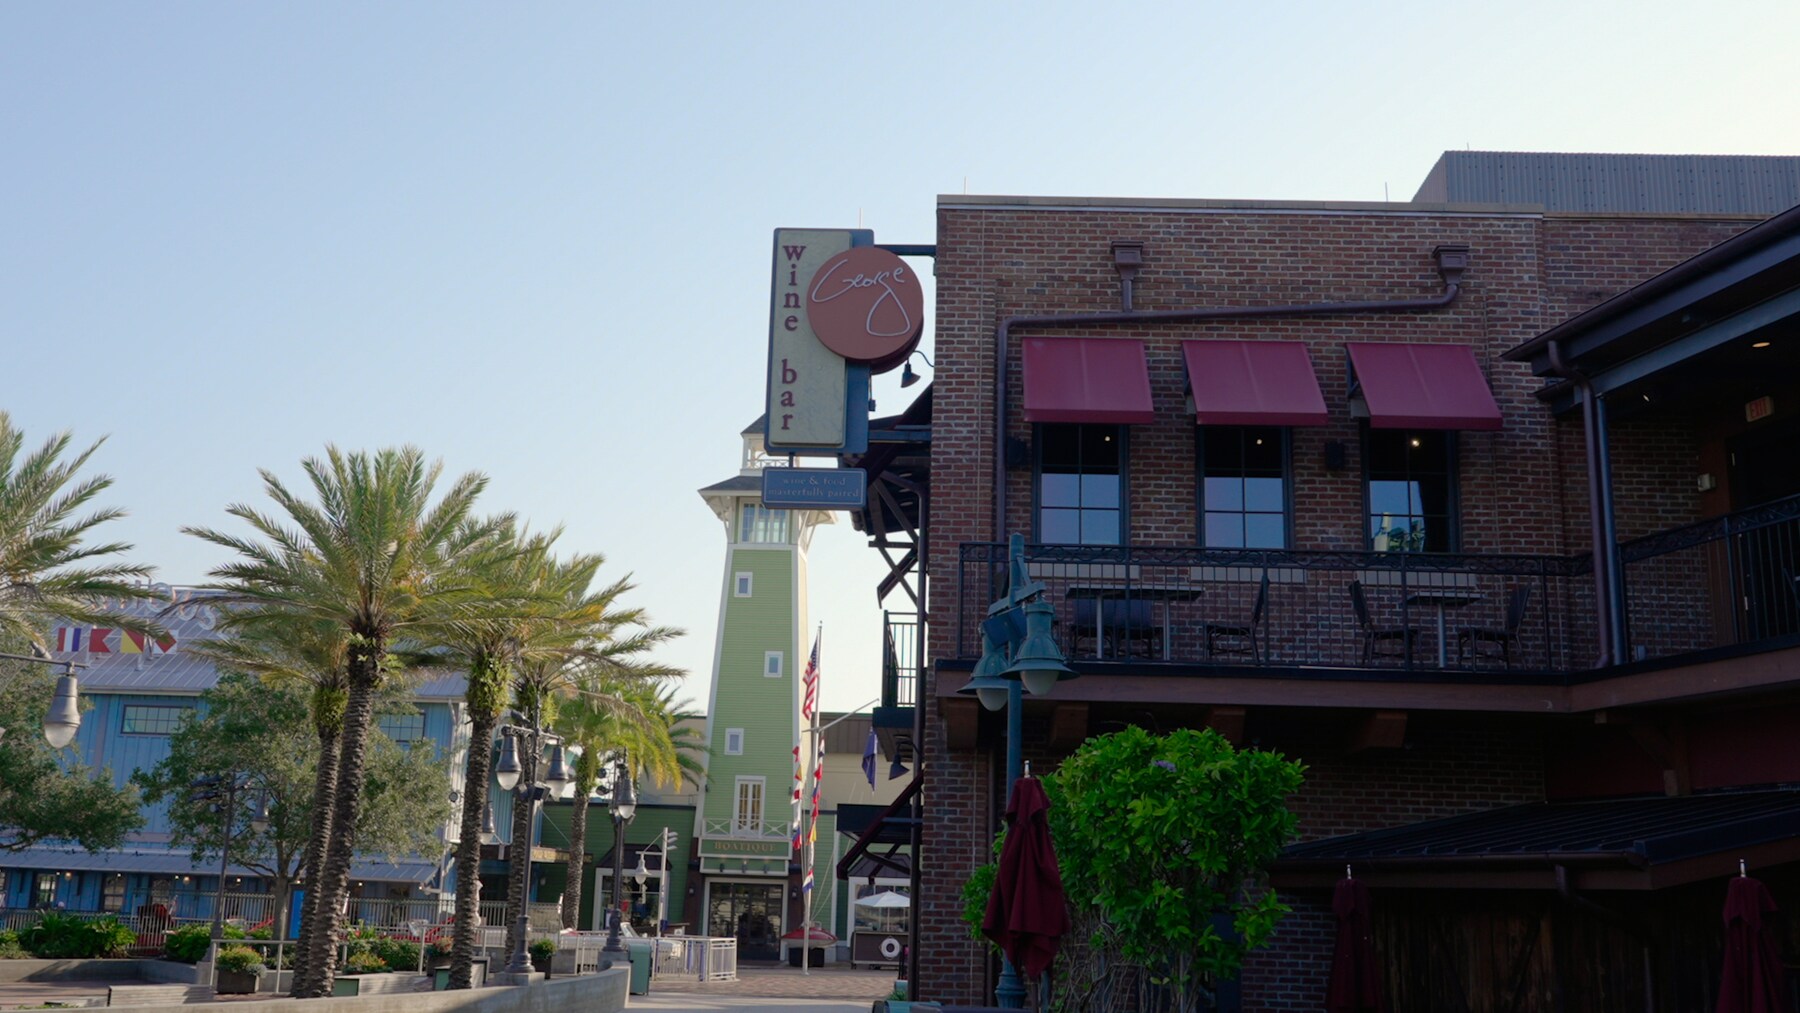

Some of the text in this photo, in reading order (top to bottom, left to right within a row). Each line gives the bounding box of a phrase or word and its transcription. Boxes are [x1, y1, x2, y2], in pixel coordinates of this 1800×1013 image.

[780, 245, 806, 430] wine bar
[783, 475, 846, 486] wine & food
[767, 487, 860, 498] masterfully paired
[714, 841, 776, 853] BOATIQUE
